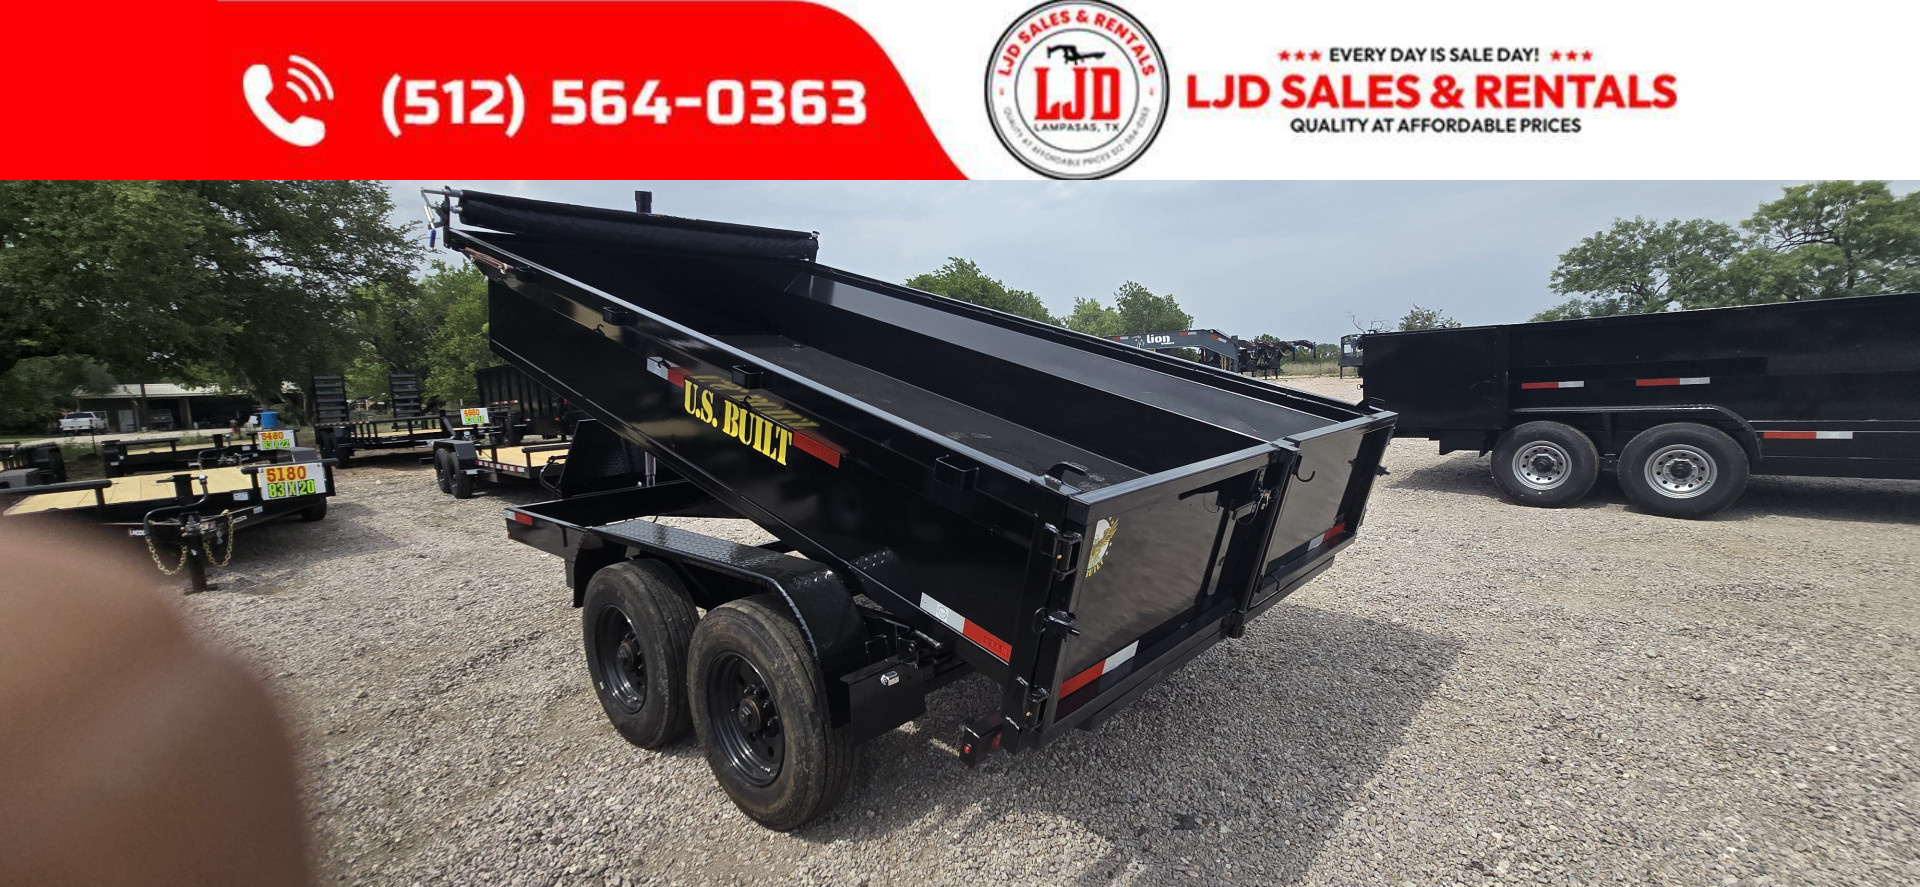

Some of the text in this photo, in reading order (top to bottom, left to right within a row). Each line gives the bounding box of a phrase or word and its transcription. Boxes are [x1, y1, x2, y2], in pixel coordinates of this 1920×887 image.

[1146, 334, 1171, 344] lion
[684, 379, 793, 466] U.S. BUILT
[261, 431, 284, 441] 5480
[280, 439, 290, 449] 22
[266, 465, 307, 482] 5180
[268, 481, 286, 498] 83
[287, 481, 297, 496] X
[298, 479, 316, 495] 20
